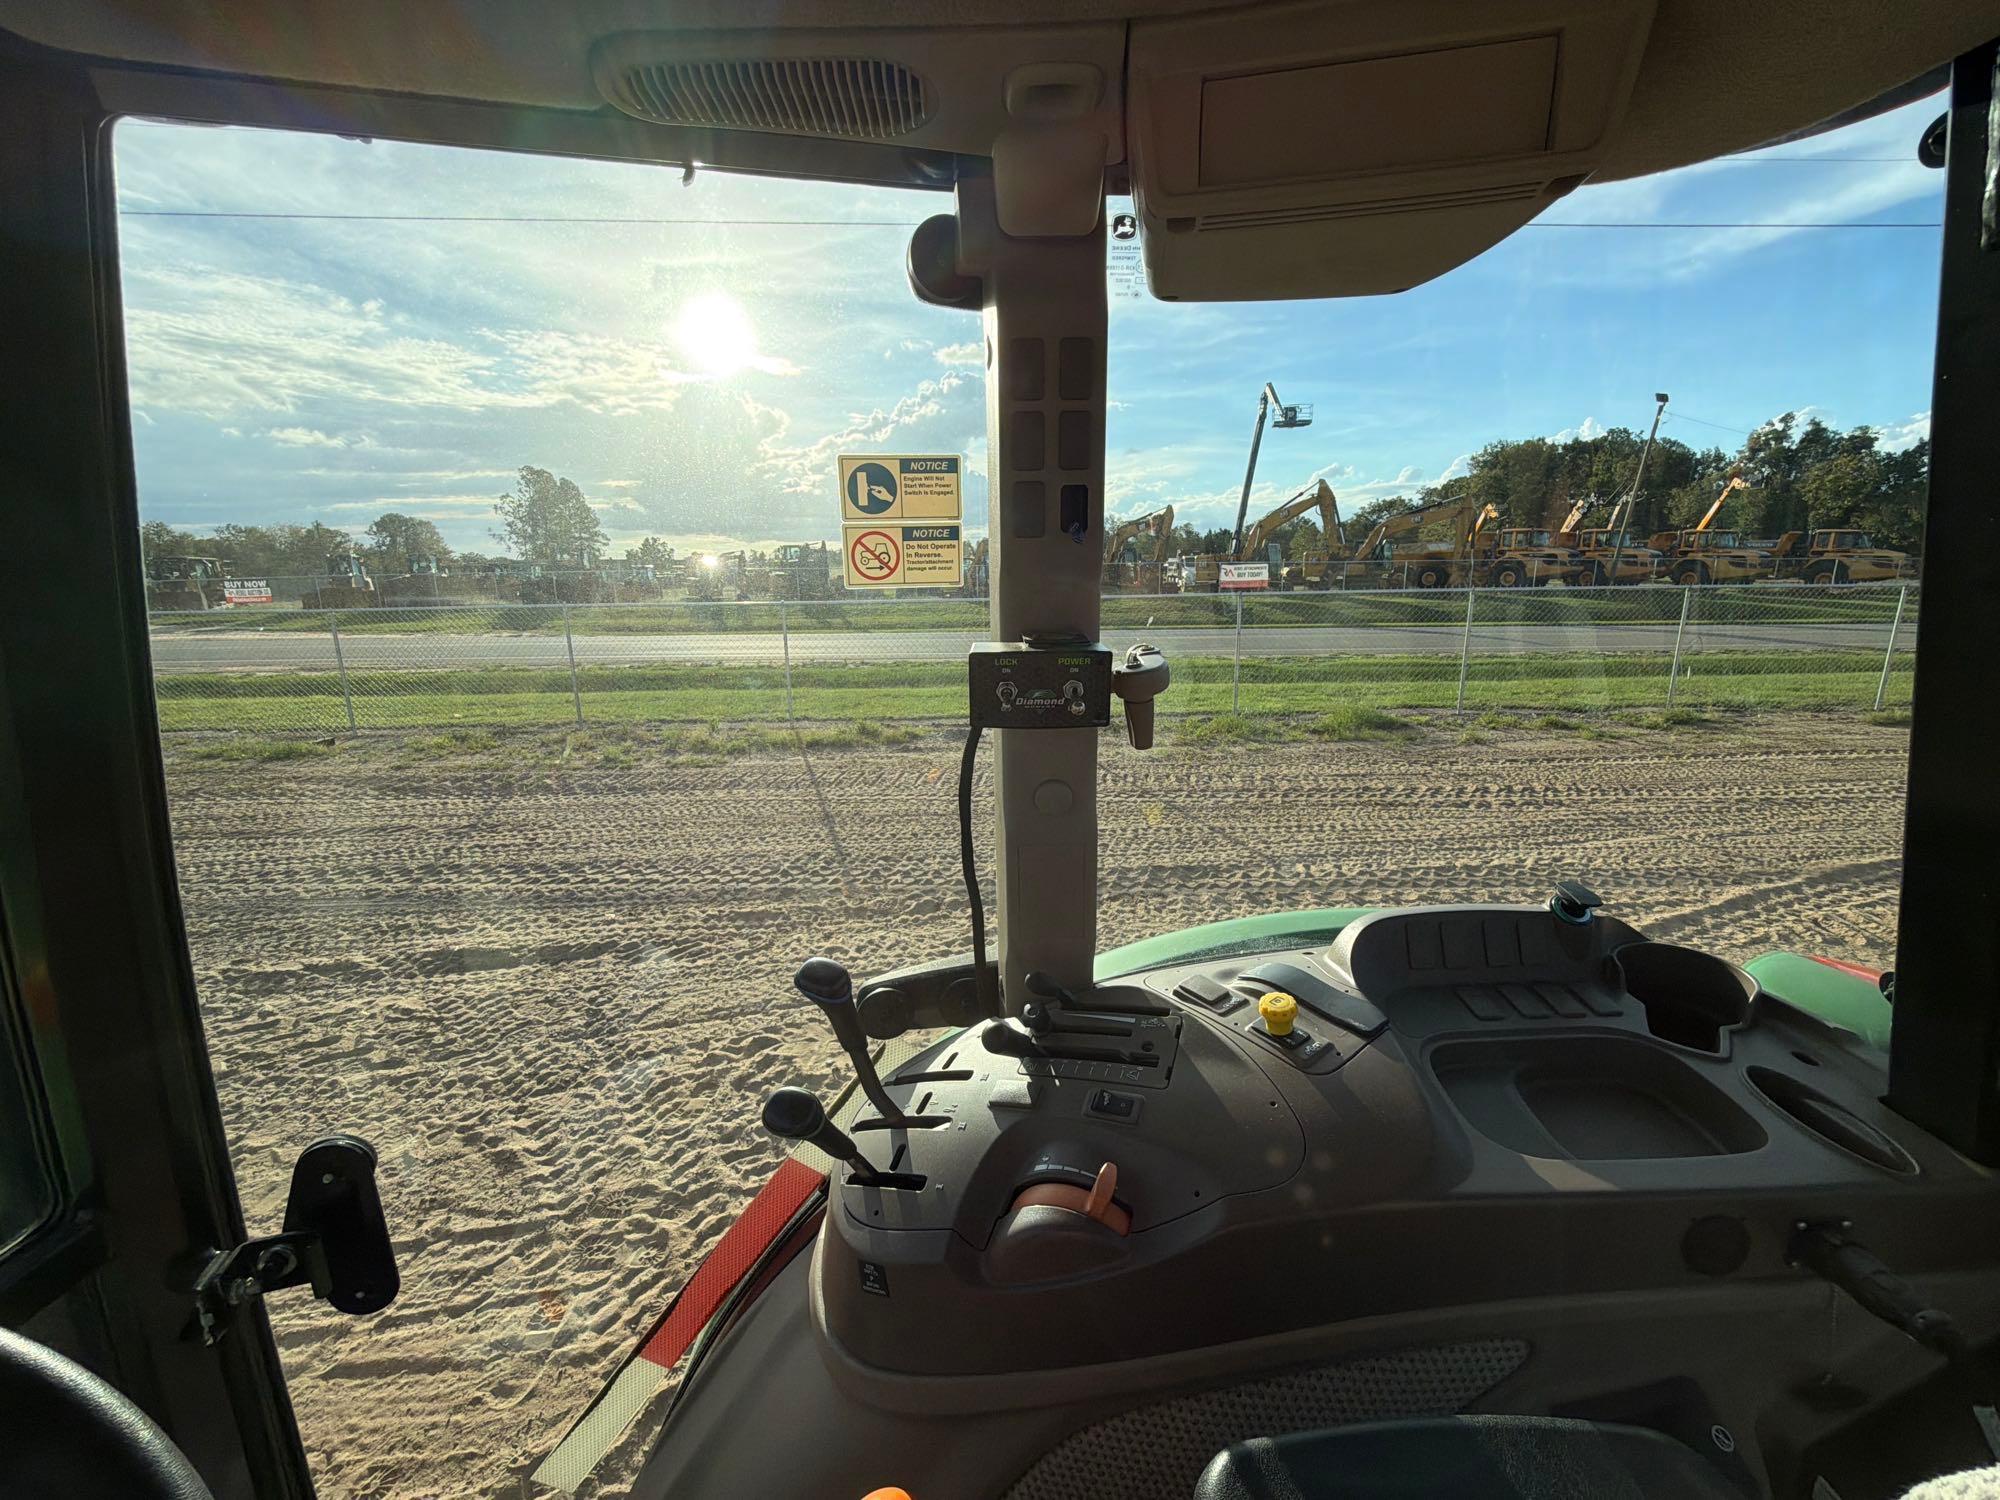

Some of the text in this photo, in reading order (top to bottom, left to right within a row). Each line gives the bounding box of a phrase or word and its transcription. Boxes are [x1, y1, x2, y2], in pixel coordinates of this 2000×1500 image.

[910, 461, 949, 471] NOTICE
[912, 529, 951, 538] NOTICE
[914, 551, 944, 559] Reverse.
[224, 580, 267, 588] BUY NOW
[995, 658, 1019, 666] LOCK
[1058, 657, 1092, 665] POWER
[1016, 697, 1066, 706] Diamond
